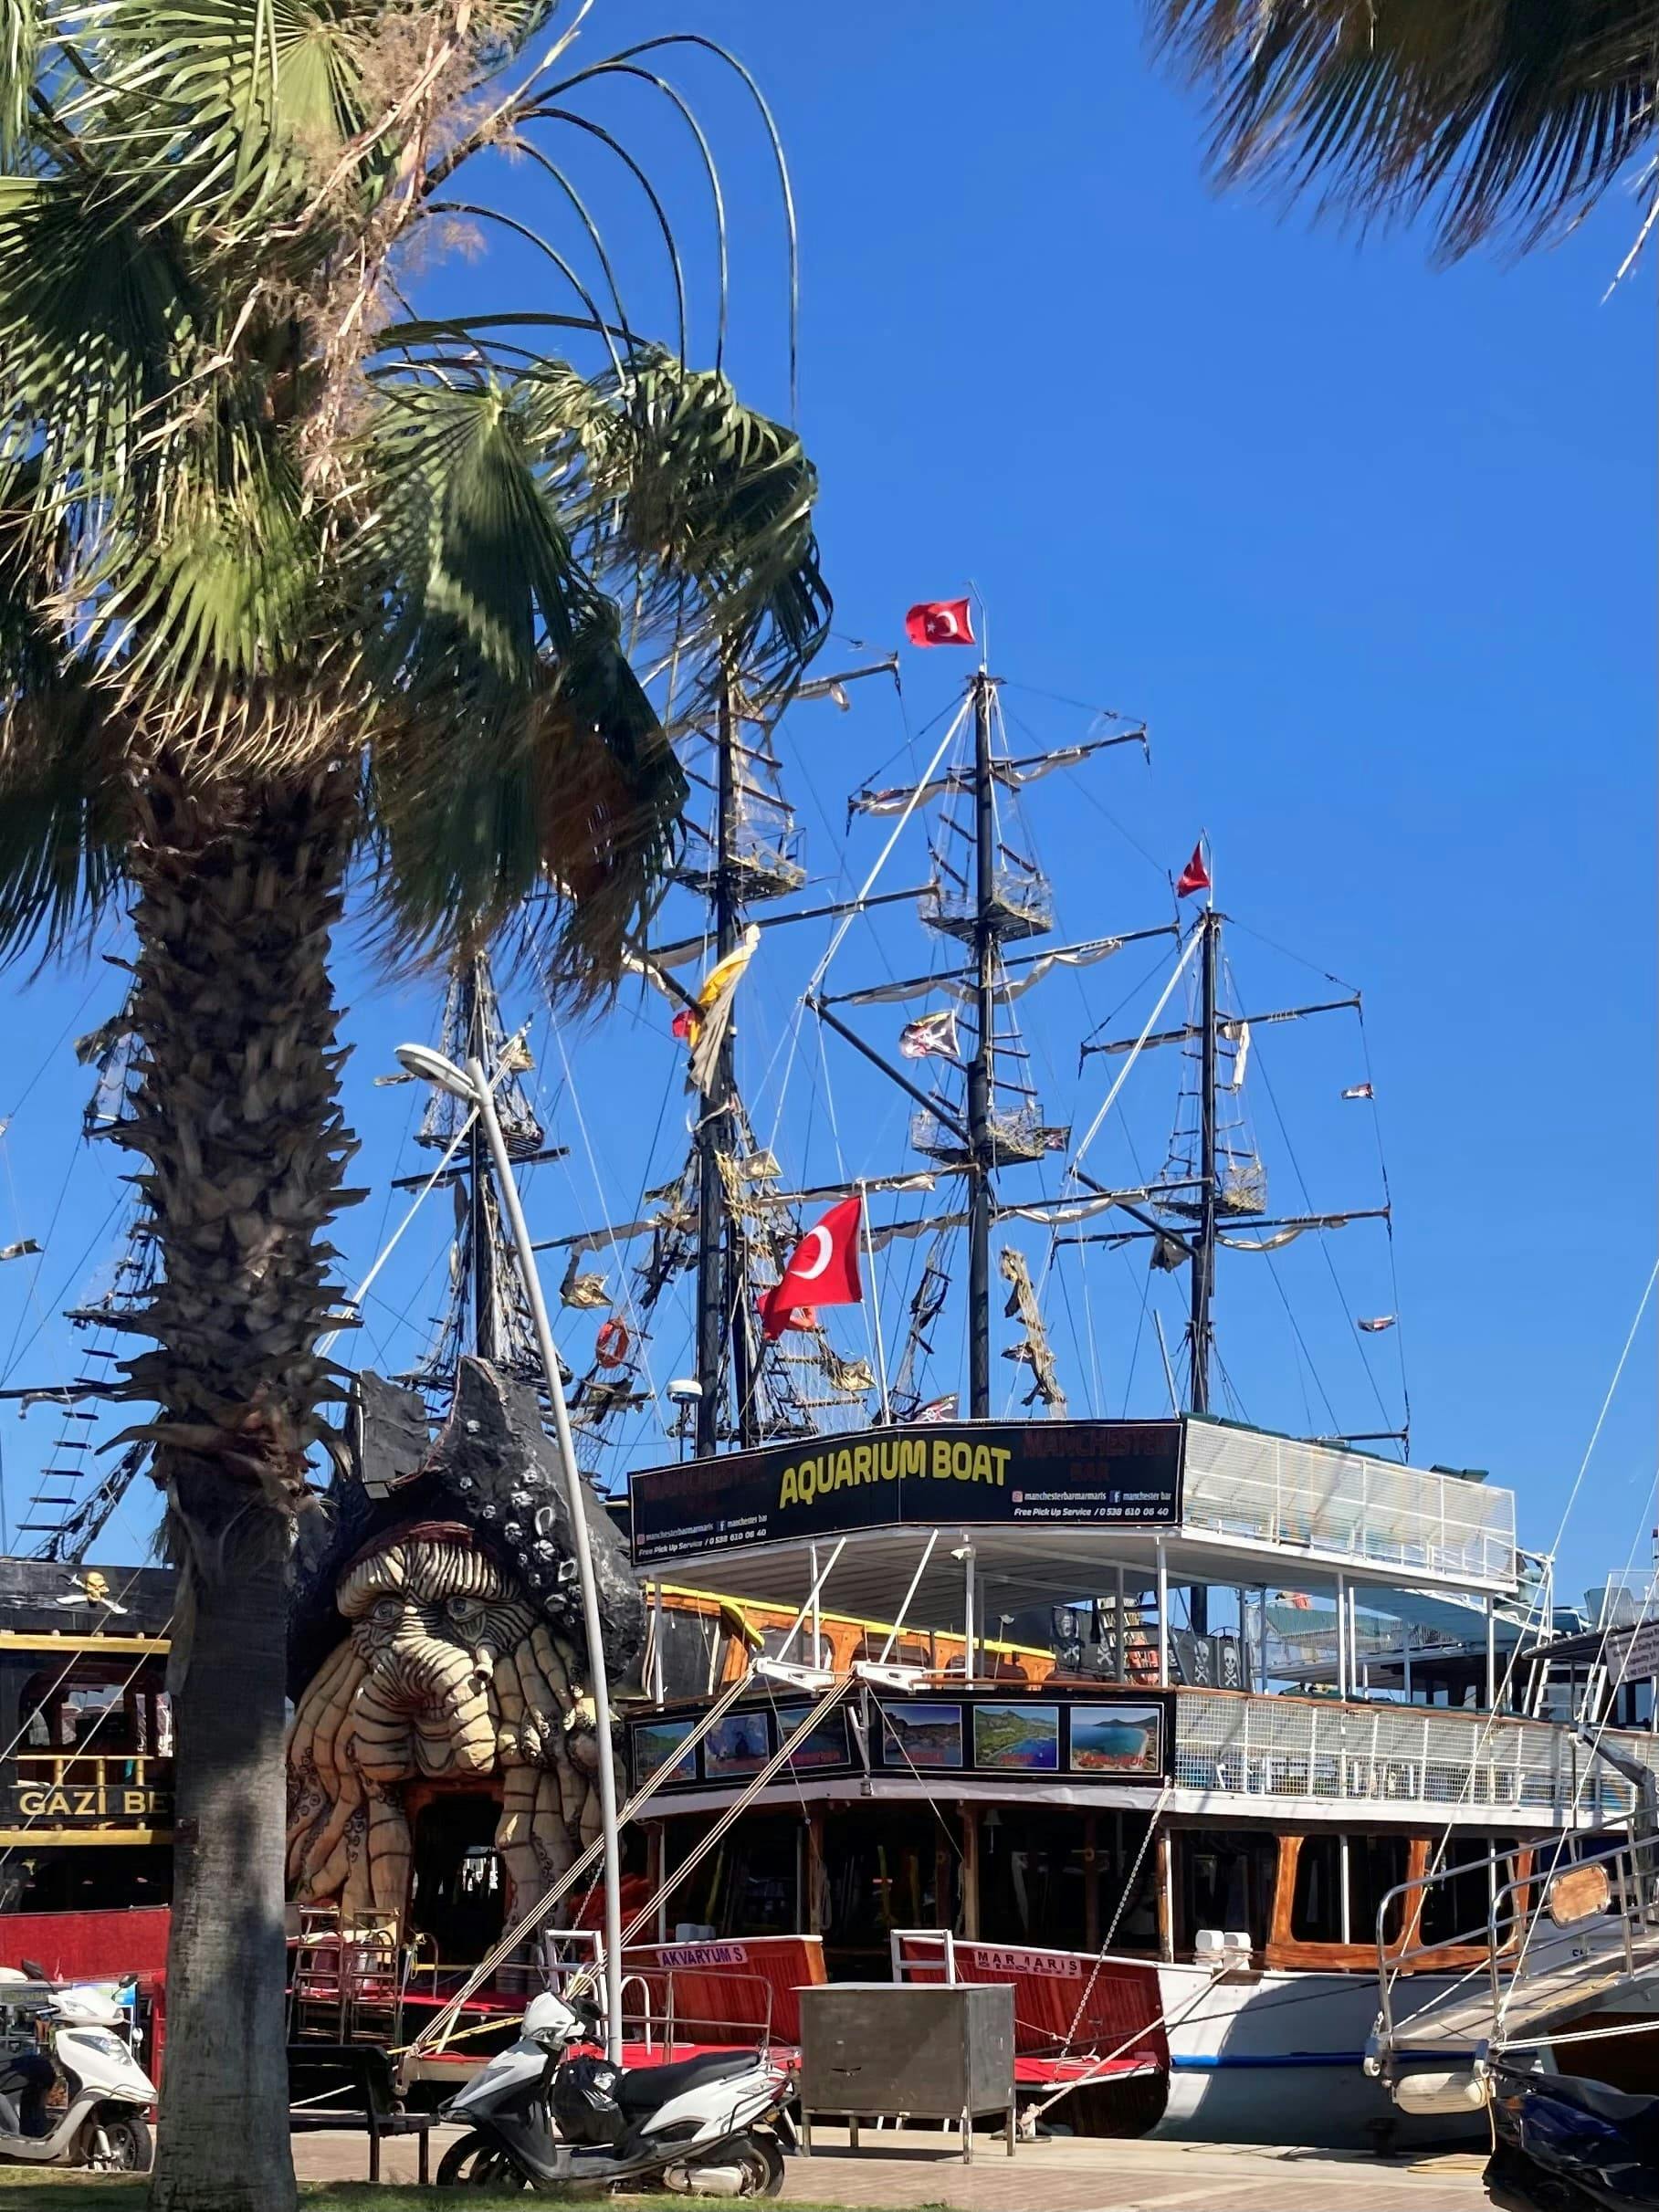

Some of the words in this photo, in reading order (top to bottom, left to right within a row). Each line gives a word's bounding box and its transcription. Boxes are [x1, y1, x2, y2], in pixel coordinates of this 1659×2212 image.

[779, 1440, 927, 1510] AQUARIUM
[932, 1440, 1012, 1486] BOAT
[1013, 1508, 1032, 1516] Free
[1033, 1508, 1050, 1516] Pick
[1050, 1508, 1061, 1517] Up
[1062, 1507, 1092, 1516] Service
[123, 1790, 172, 1815] BE
[662, 1947, 731, 1966] AKVARYUM
[734, 1947, 743, 1962] S
